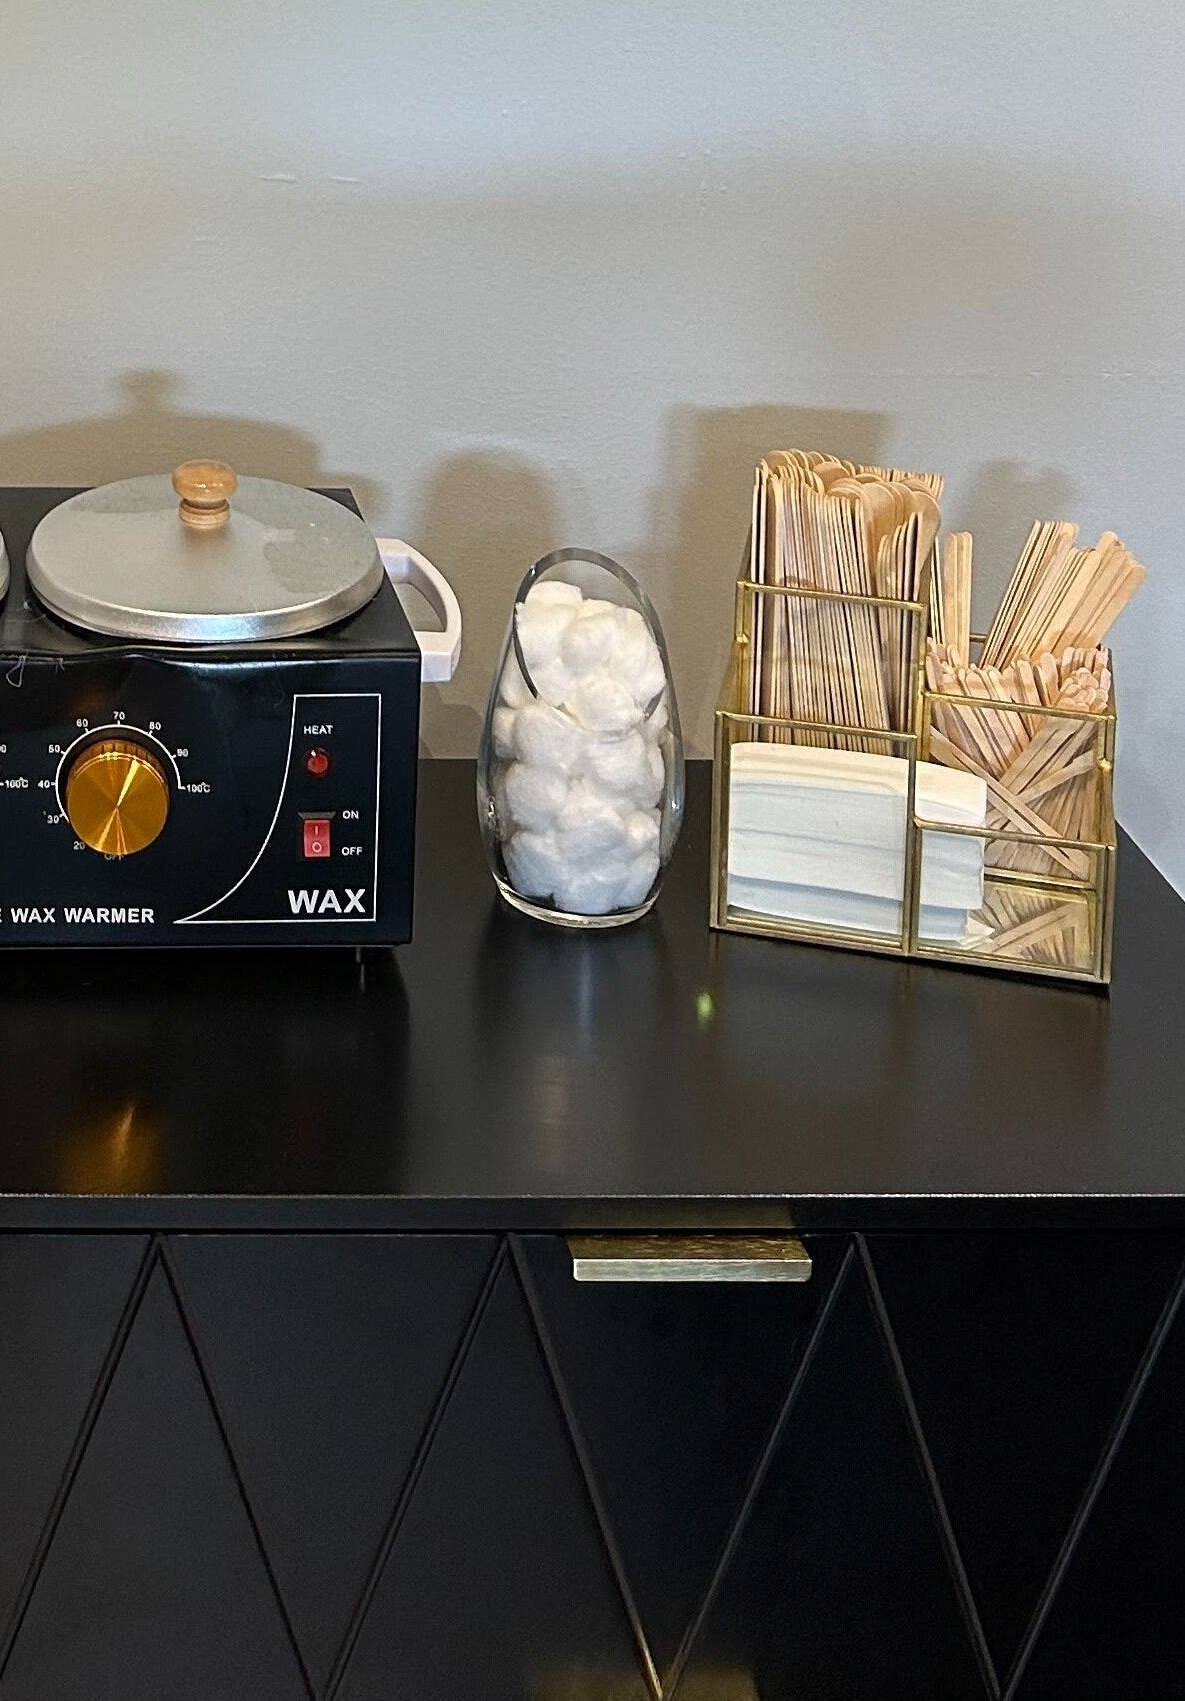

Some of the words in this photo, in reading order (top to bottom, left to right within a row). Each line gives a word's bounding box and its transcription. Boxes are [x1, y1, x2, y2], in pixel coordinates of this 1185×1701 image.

[113, 711, 125, 720] 70
[304, 725, 333, 734] HEAT
[37, 779, 51, 789] 40
[47, 814, 60, 824] 30
[342, 810, 359, 820] ON
[73, 841, 85, 850] 20
[341, 846, 363, 856] OFF
[288, 889, 366, 914] WAX
[11, 908, 56, 924] WAX
[64, 908, 155, 924] WARMER
